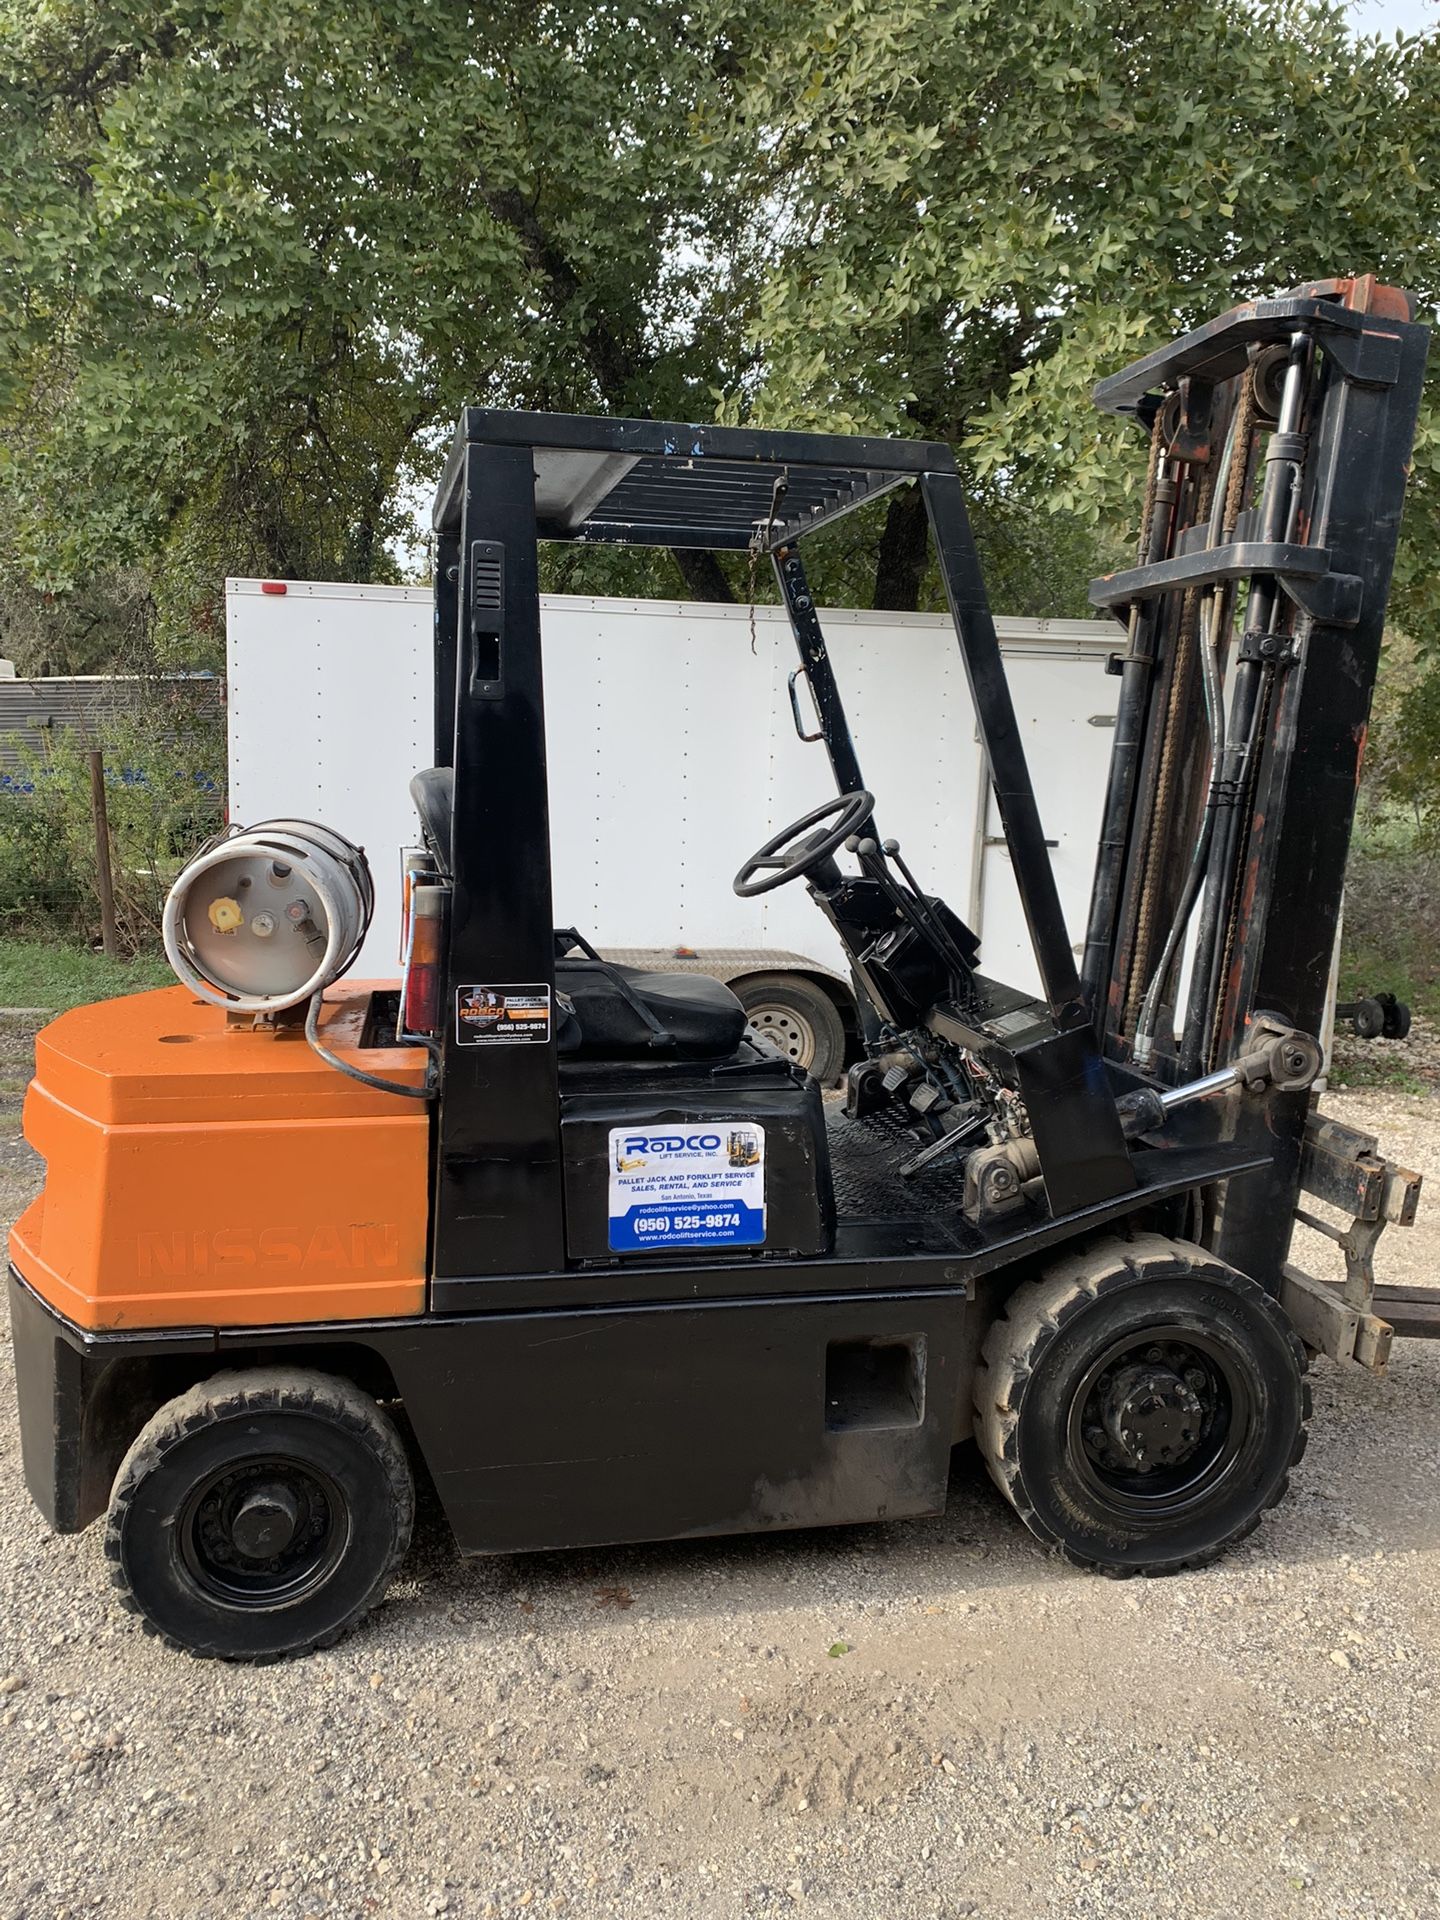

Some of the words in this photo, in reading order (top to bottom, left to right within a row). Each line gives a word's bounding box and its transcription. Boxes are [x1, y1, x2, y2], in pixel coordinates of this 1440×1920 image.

[460, 1008, 504, 1016] RODCO
[687, 1173, 722, 1181] FORKLIFT
[640, 1203, 734, 1214] rodcoliftservice@yahoo.com
[634, 1216, 670, 1234] (956)
[674, 1214, 740, 1230] 525-9874
[639, 1230, 734, 1241] www.rodcoliftservice.com
[136, 1225, 399, 1277] NISSAN
